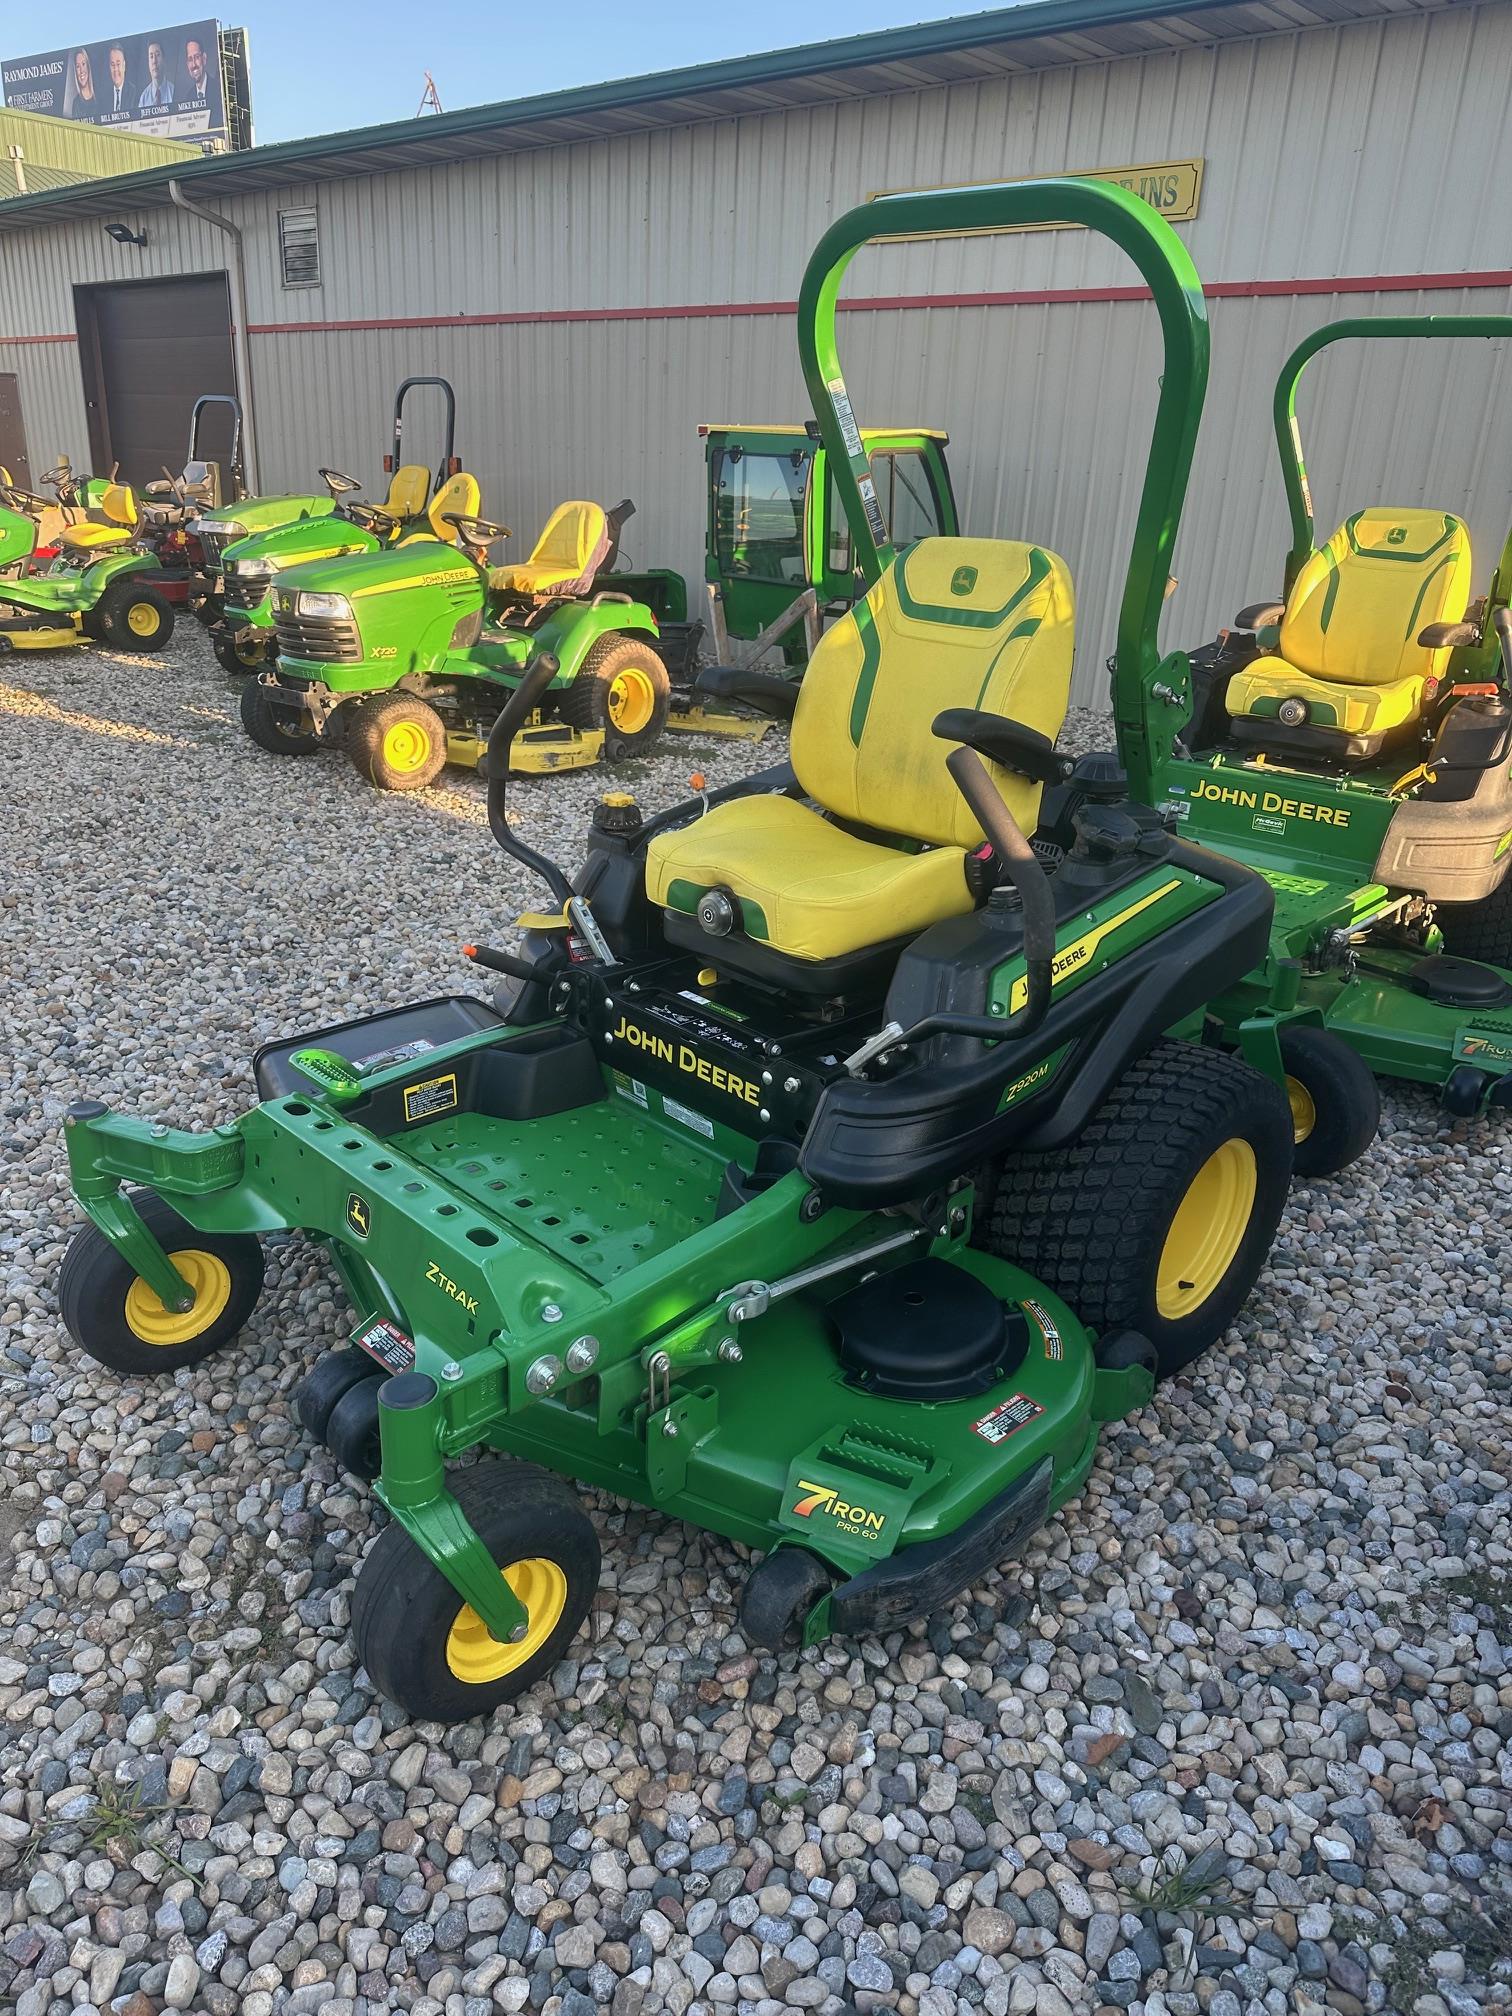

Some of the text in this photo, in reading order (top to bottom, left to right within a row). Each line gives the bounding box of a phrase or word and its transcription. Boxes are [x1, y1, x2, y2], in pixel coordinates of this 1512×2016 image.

[4, 62, 63, 83] RAYMOND JAMES
[13, 94, 28, 106] FIRST
[178, 103, 193, 111] MIKE
[140, 108, 151, 118] JEFF
[421, 570, 470, 586] JOHN DEERE
[370, 647, 397, 658] X720
[1190, 780, 1352, 828] JOHN DEERE
[1051, 946, 1087, 976] DEERE
[613, 1016, 673, 1064] JOHN
[679, 1045, 760, 1107] DEERE
[1006, 1063, 1049, 1103] Z920M
[425, 1260, 480, 1316] ZTRAK
[836, 1520, 878, 1541] PRO 60
